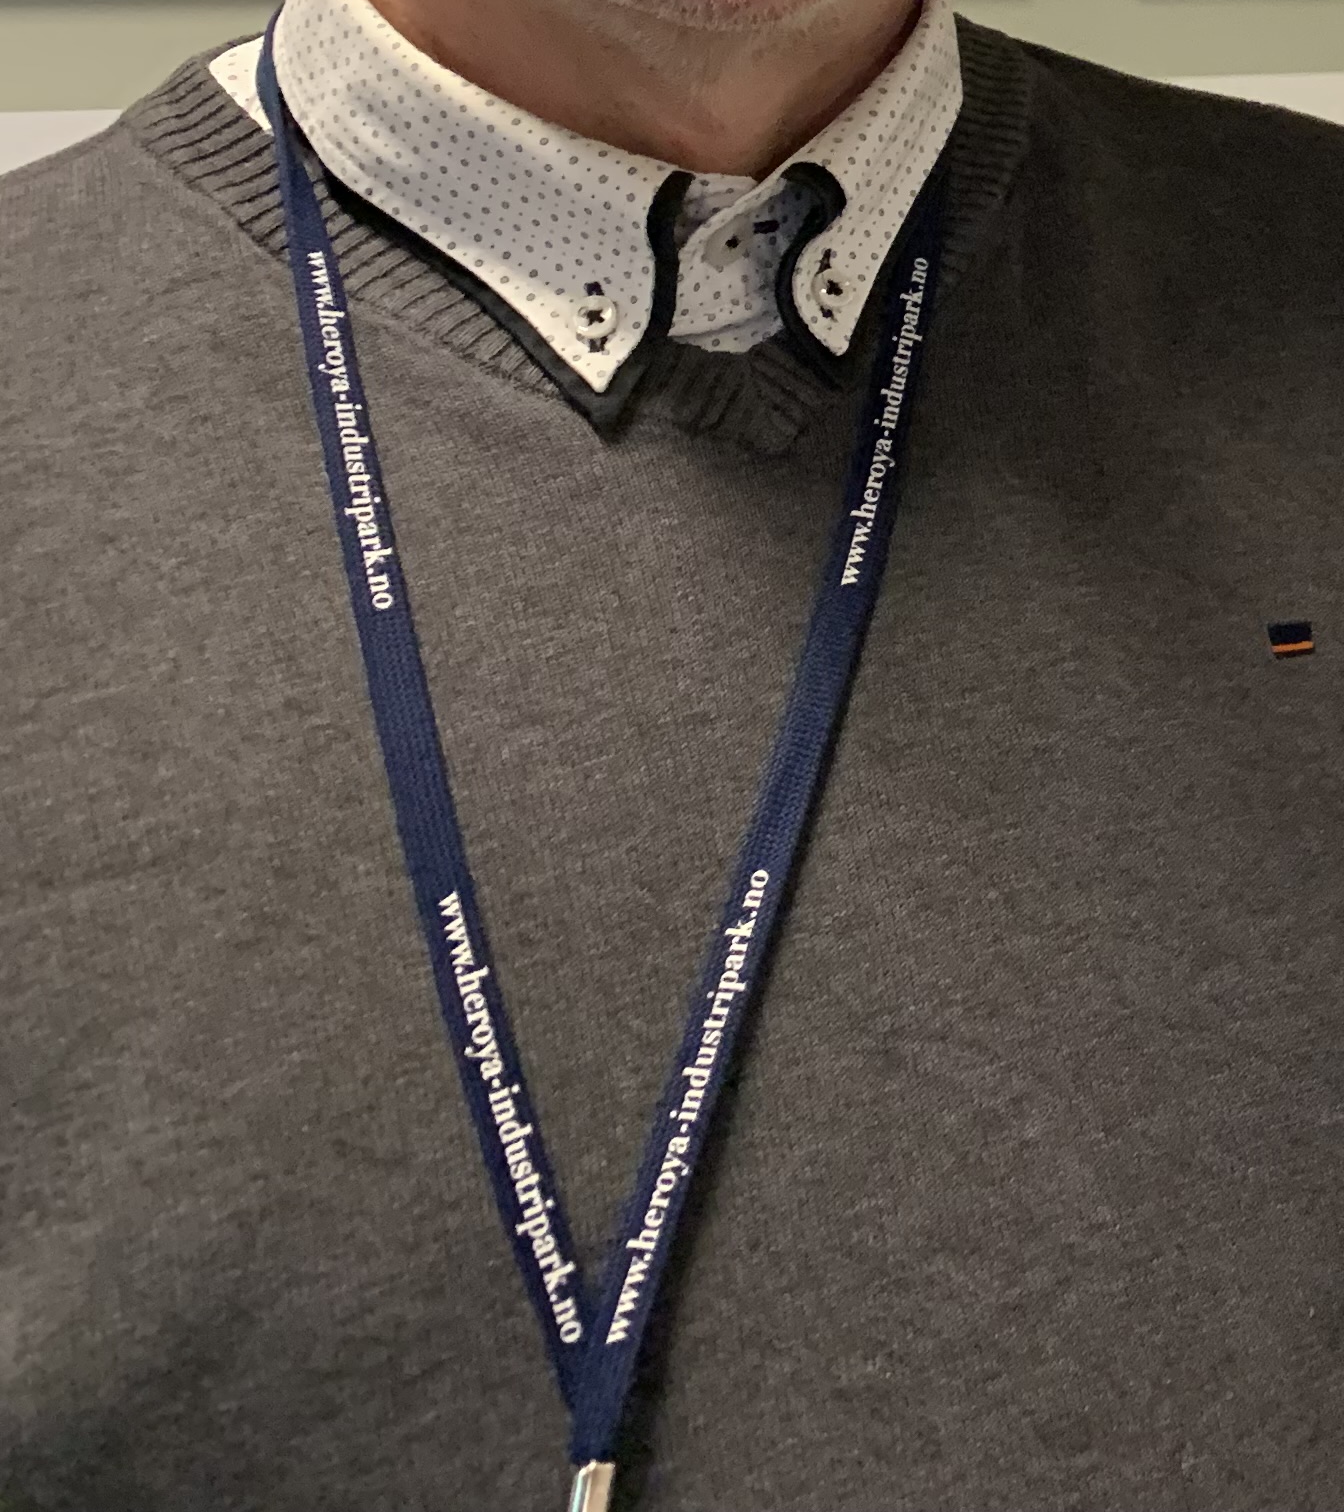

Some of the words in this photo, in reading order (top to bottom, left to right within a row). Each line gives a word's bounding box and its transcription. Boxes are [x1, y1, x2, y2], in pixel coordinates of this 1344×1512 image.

[307, 250, 394, 612] www.heroya-industripark.no
[840, 257, 930, 587] www.heroya-industripark.no
[437, 889, 583, 1345] www.heroya-industripark.no
[605, 868, 770, 1346] www.heroya-industripark.no
